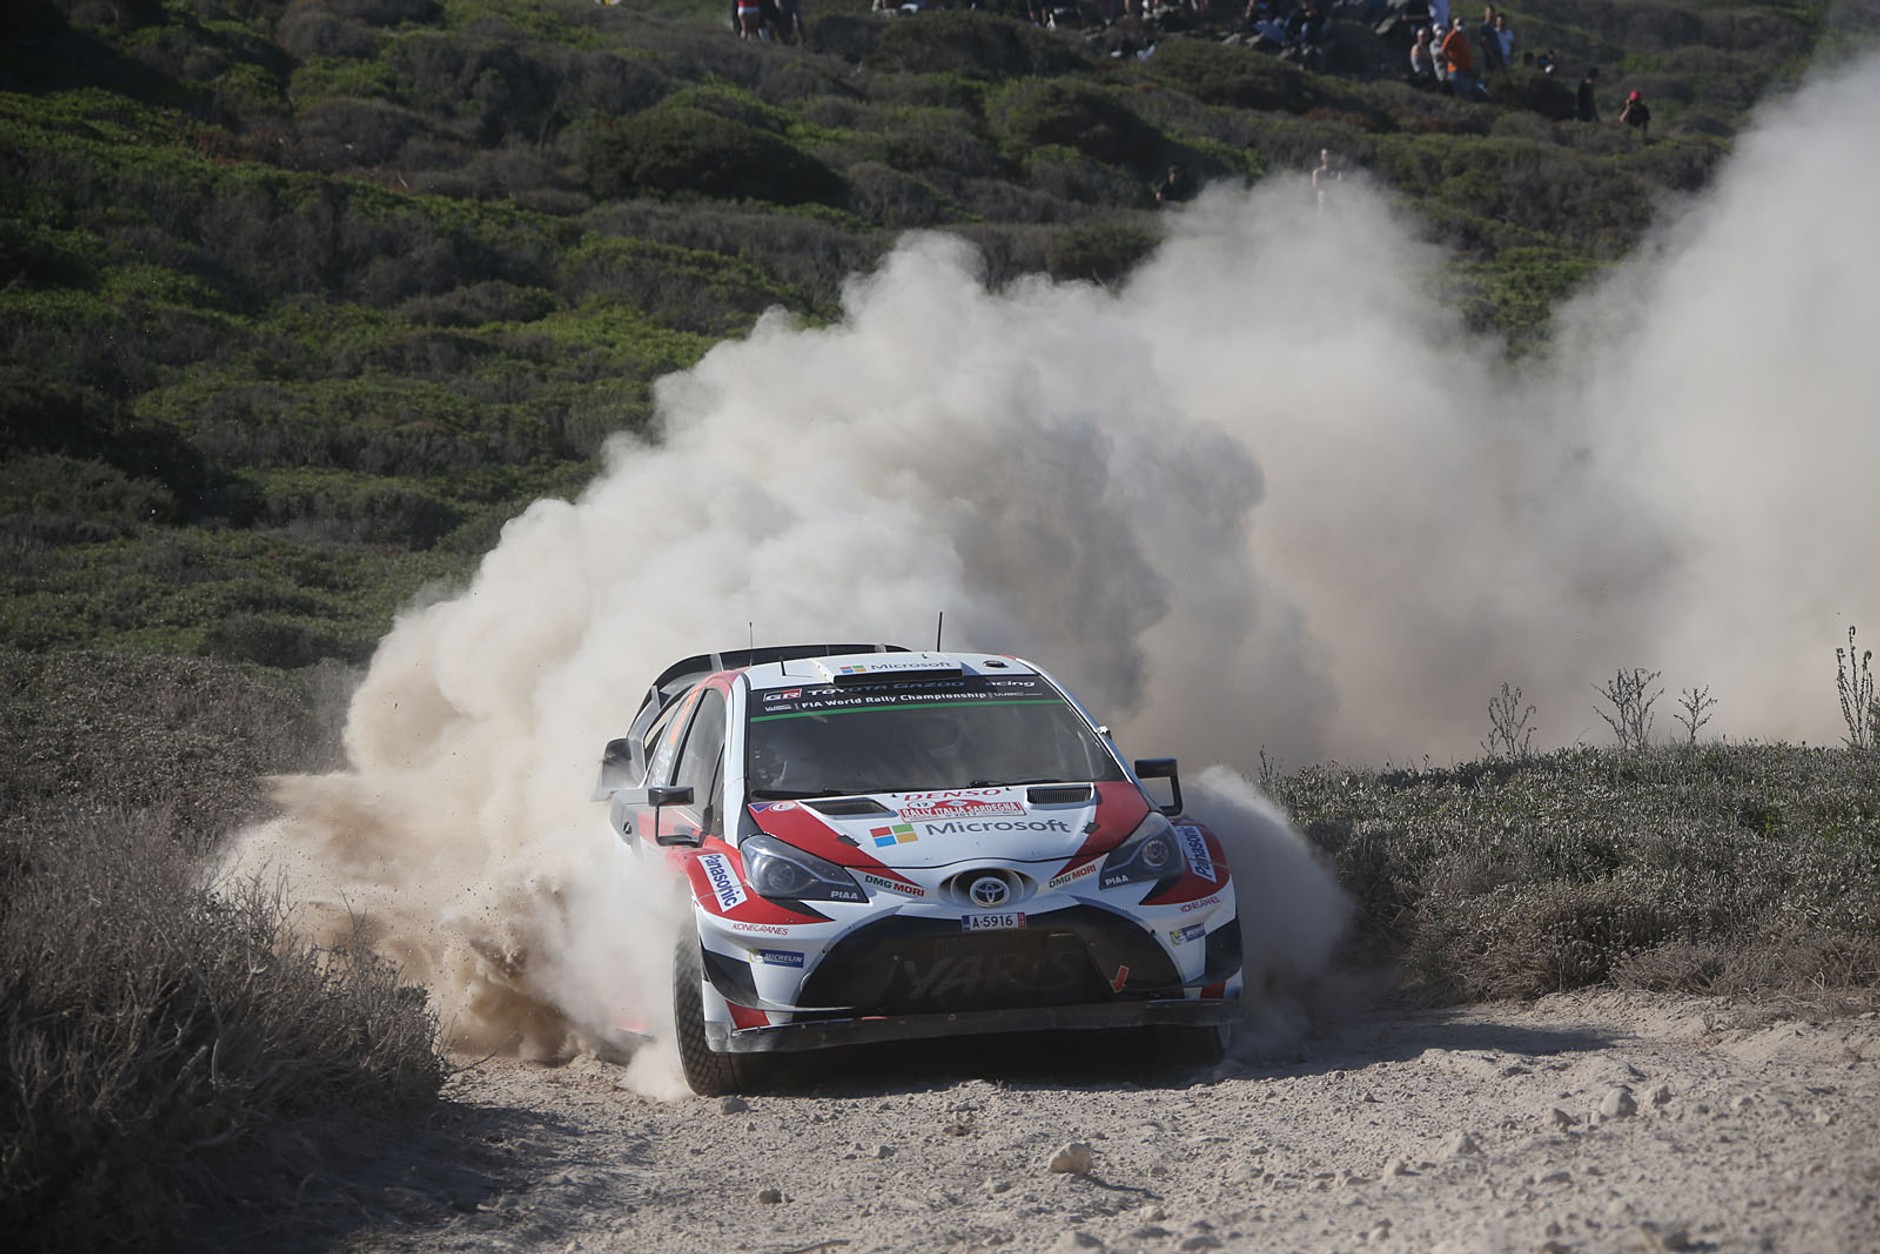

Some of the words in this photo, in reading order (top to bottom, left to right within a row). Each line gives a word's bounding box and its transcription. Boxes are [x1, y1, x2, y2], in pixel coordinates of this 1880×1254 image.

[871, 661, 951, 671] Microsoft
[765, 691, 801, 702] GR
[807, 684, 888, 696] TOYOTA
[893, 681, 964, 689] GAZOO
[984, 680, 1036, 688] acing
[801, 701, 823, 709] FIA
[825, 698, 862, 707] World
[866, 695, 897, 704] Rally
[900, 690, 987, 701] Championship
[904, 789, 1002, 801] DENSO
[902, 808, 933, 819] RALLY
[934, 804, 967, 817] ITALIA
[966, 801, 1019, 814] SARDEGNA
[926, 819, 1072, 836] Microsoft
[703, 854, 738, 908] Panasonic
[1049, 874, 1071, 889] DMG
[1071, 864, 1097, 880] MORI
[1104, 875, 1129, 886] PIAA
[865, 874, 892, 889] DMG
[892, 883, 925, 897] MORI
[830, 890, 858, 900] PIAA
[732, 923, 789, 936] KONECRANES
[972, 915, 1014, 929] A-5916
[764, 953, 803, 963] MICHELIN
[904, 951, 1078, 1000] YARIS
